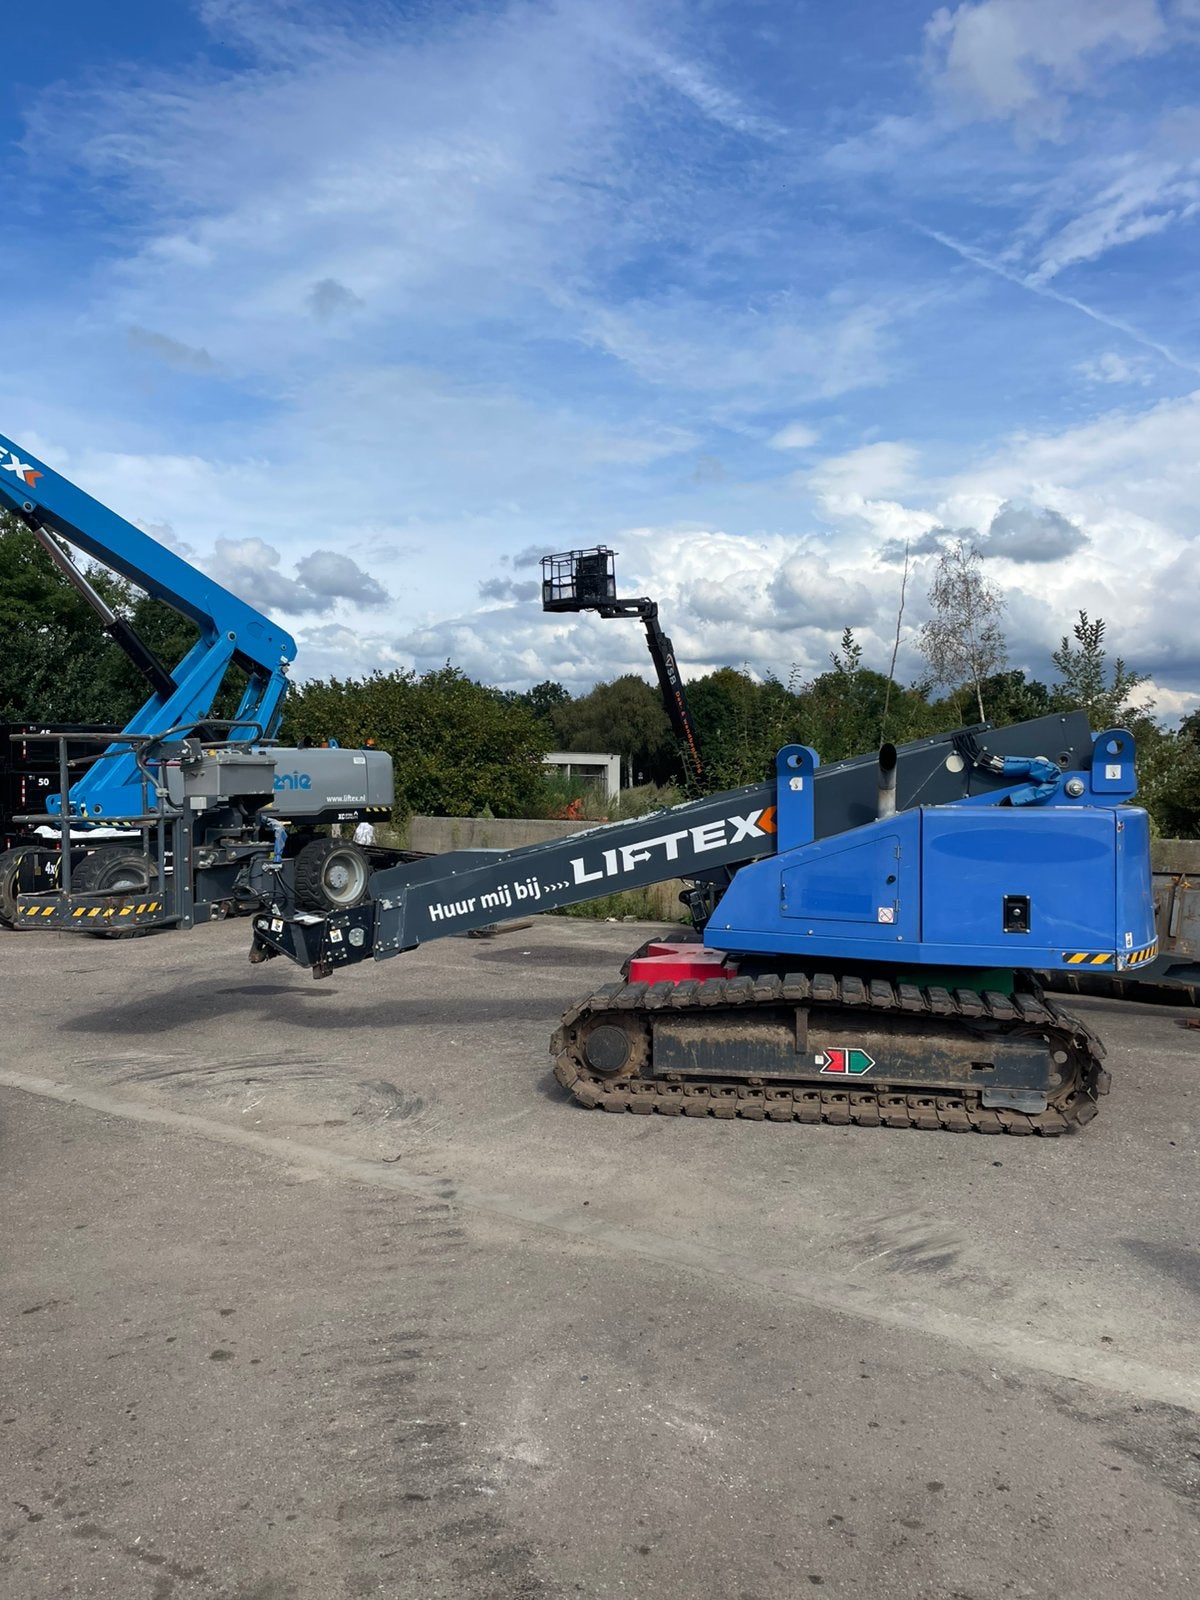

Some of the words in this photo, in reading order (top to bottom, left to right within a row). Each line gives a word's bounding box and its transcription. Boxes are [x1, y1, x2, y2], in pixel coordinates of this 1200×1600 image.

[38, 778, 49, 786] 50
[273, 770, 312, 790] enie
[570, 809, 765, 884] LIFTEX
[45, 861, 56, 874] 4x
[428, 897, 476, 922] Huur
[480, 884, 512, 910] mij
[514, 876, 540, 901] bij
